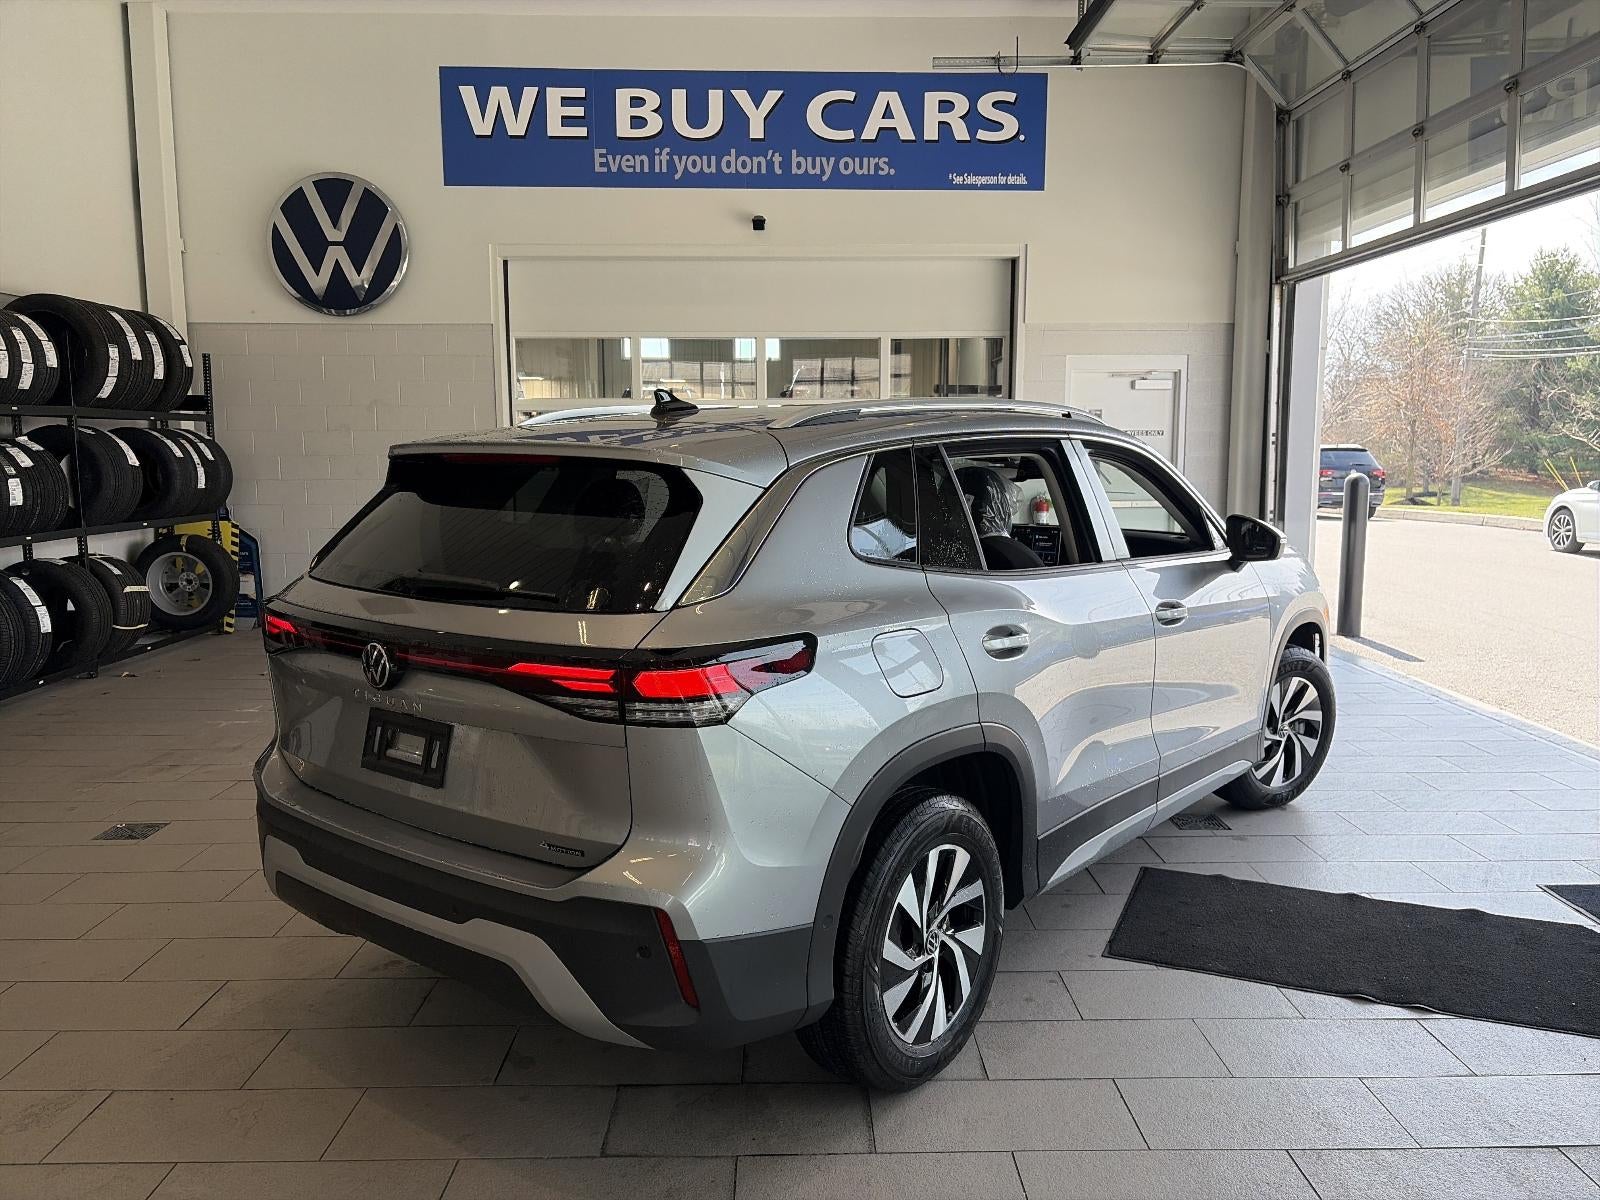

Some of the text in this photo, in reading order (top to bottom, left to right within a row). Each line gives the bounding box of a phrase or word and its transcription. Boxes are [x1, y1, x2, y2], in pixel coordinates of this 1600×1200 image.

[458, 85, 1026, 143] WE BUY CARS.
[593, 147, 896, 182] Even if you don't buy ours.
[964, 173, 997, 187] Salesperson
[998, 173, 1007, 184] for
[1007, 173, 1028, 184] details.
